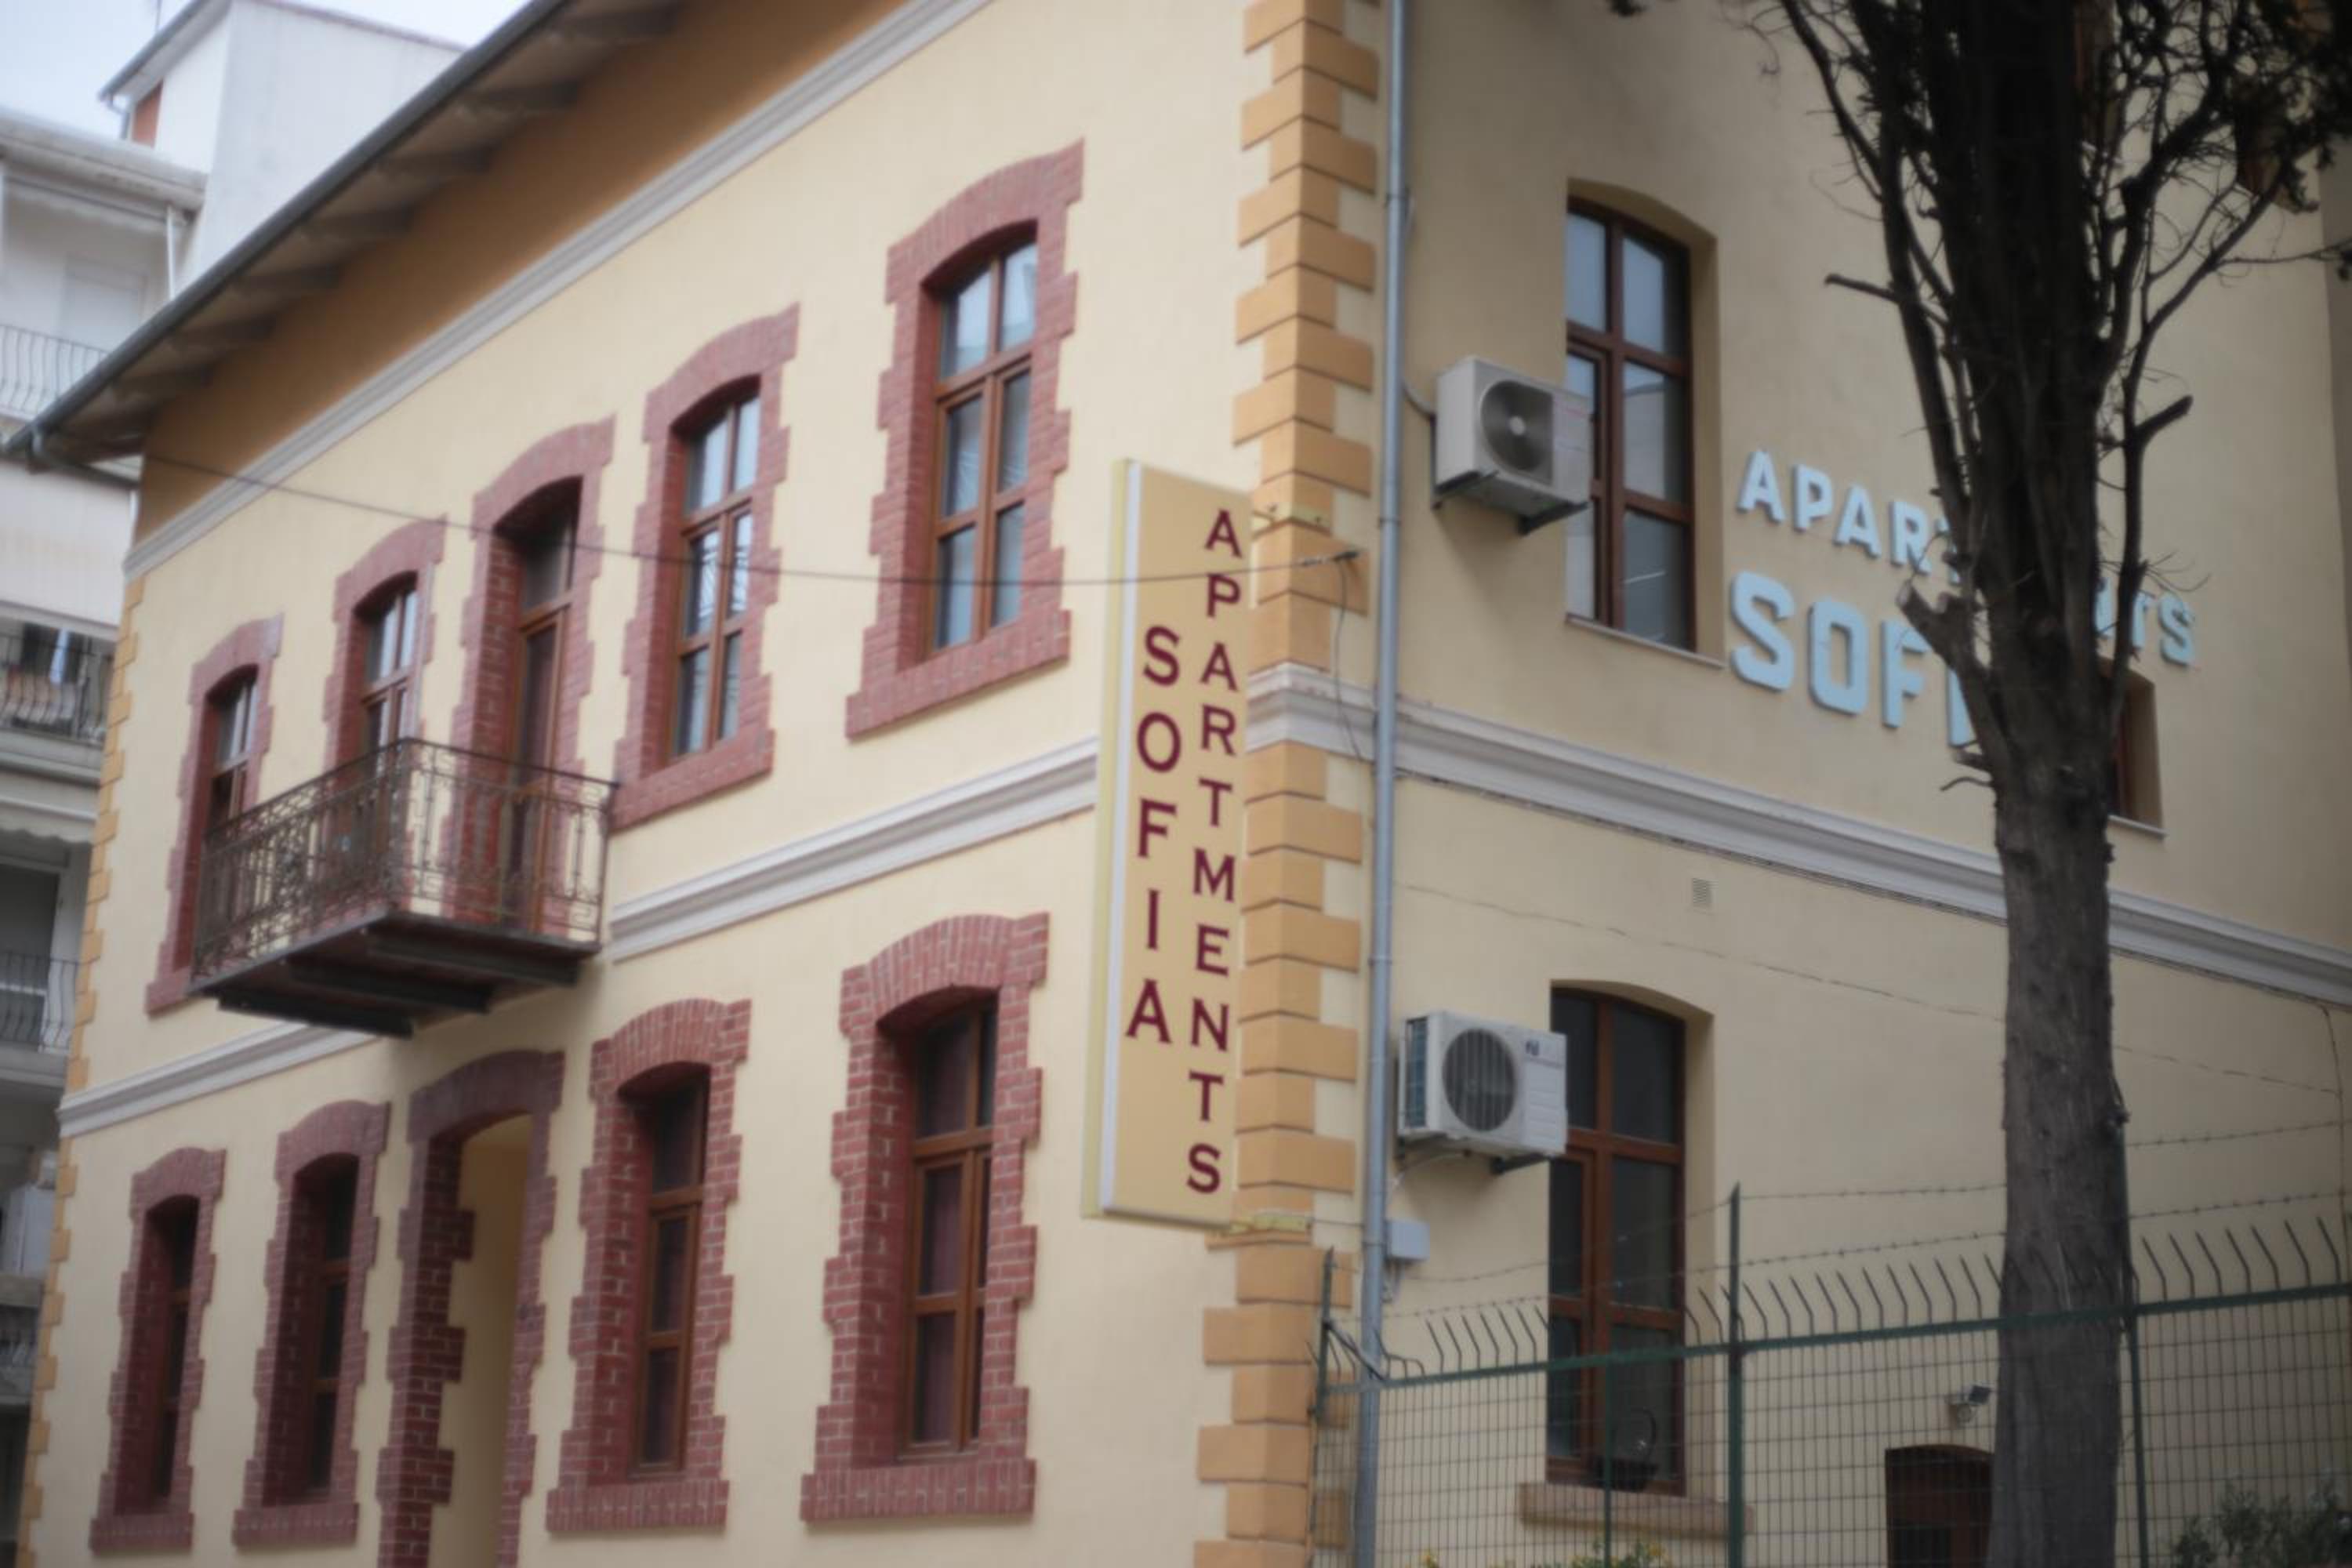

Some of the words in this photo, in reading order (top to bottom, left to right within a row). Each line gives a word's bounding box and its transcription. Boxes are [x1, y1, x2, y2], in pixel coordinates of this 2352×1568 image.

[1125, 625, 1181, 1044] SOFIA
[1186, 508, 1243, 1194] APARTMENTS
[1730, 569, 1973, 746] SOFI
